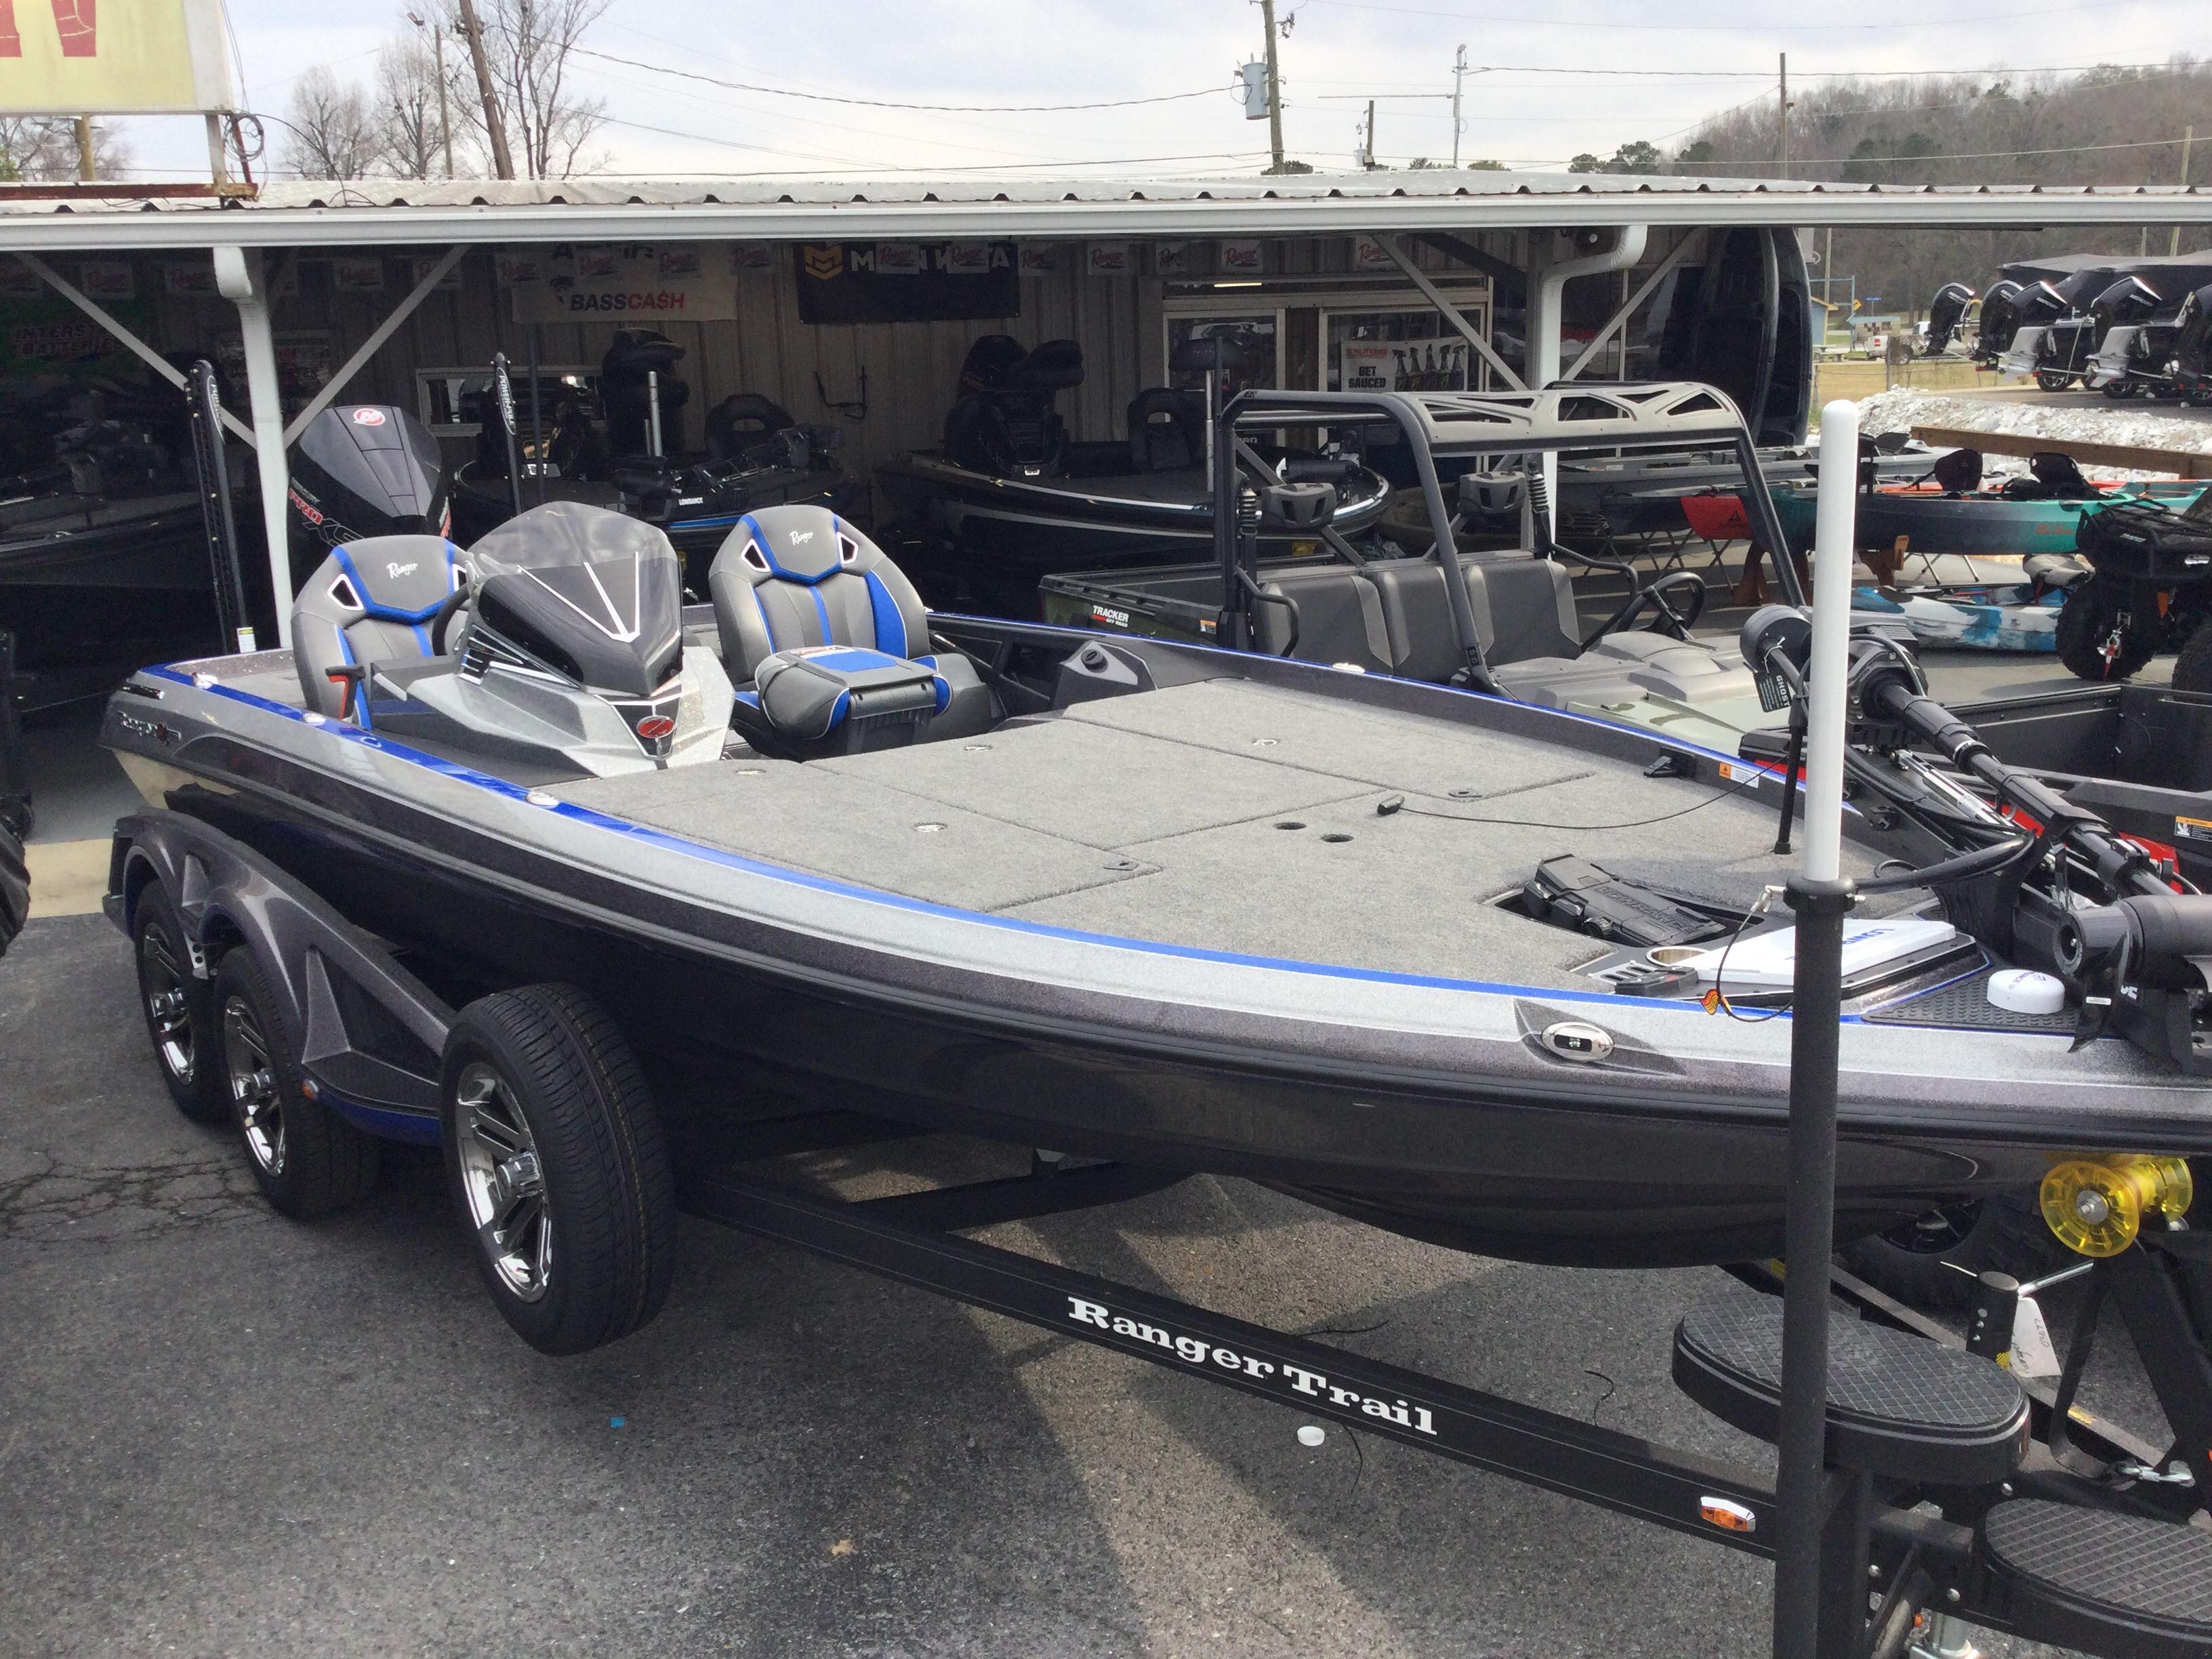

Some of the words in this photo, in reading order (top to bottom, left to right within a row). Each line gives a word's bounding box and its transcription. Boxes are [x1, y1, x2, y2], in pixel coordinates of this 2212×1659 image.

[789, 530, 814, 546] Ranger
[386, 562, 418, 579] Ranger
[1092, 605, 1130, 623] TRACKER
[1776, 674, 1791, 707] GHOST
[1067, 1296, 1275, 1380] Ranger
[1283, 1364, 1438, 1436] Trail
